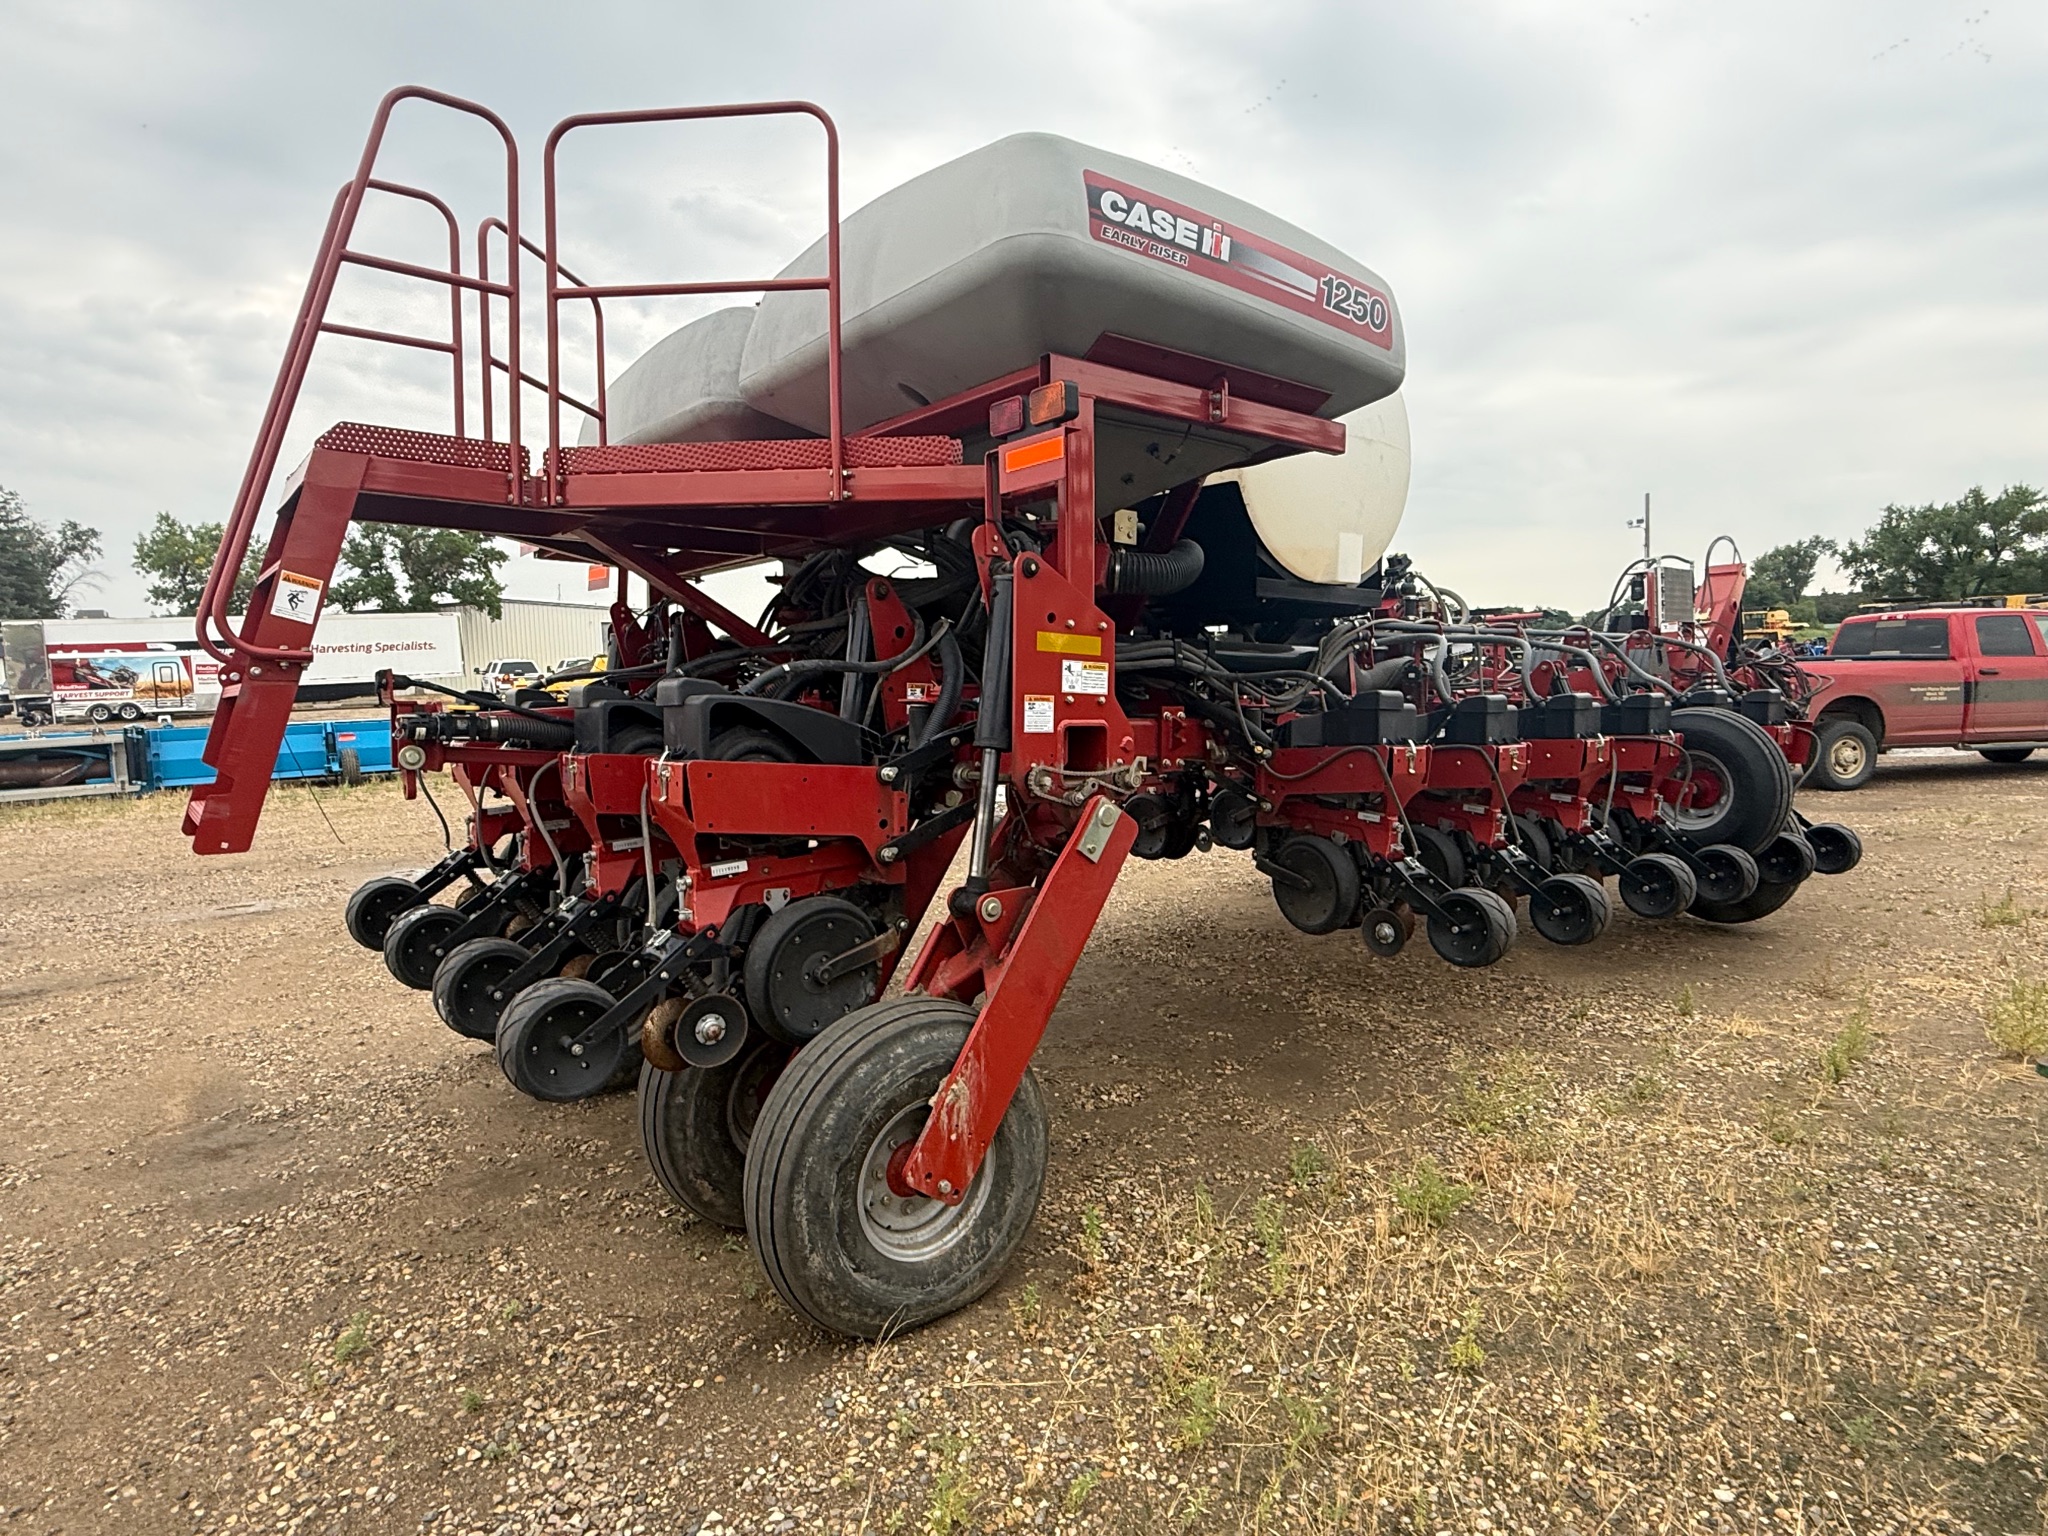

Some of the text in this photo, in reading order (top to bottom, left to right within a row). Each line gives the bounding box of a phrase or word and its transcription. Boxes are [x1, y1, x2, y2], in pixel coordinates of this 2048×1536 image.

[1100, 190, 1199, 251] CASE
[1101, 226, 1189, 265] EARLY RISER
[1321, 274, 1387, 332] 1250
[311, 641, 437, 654] Harvesting Specialists.
[57, 690, 130, 699] HARVEST SUPPORT
